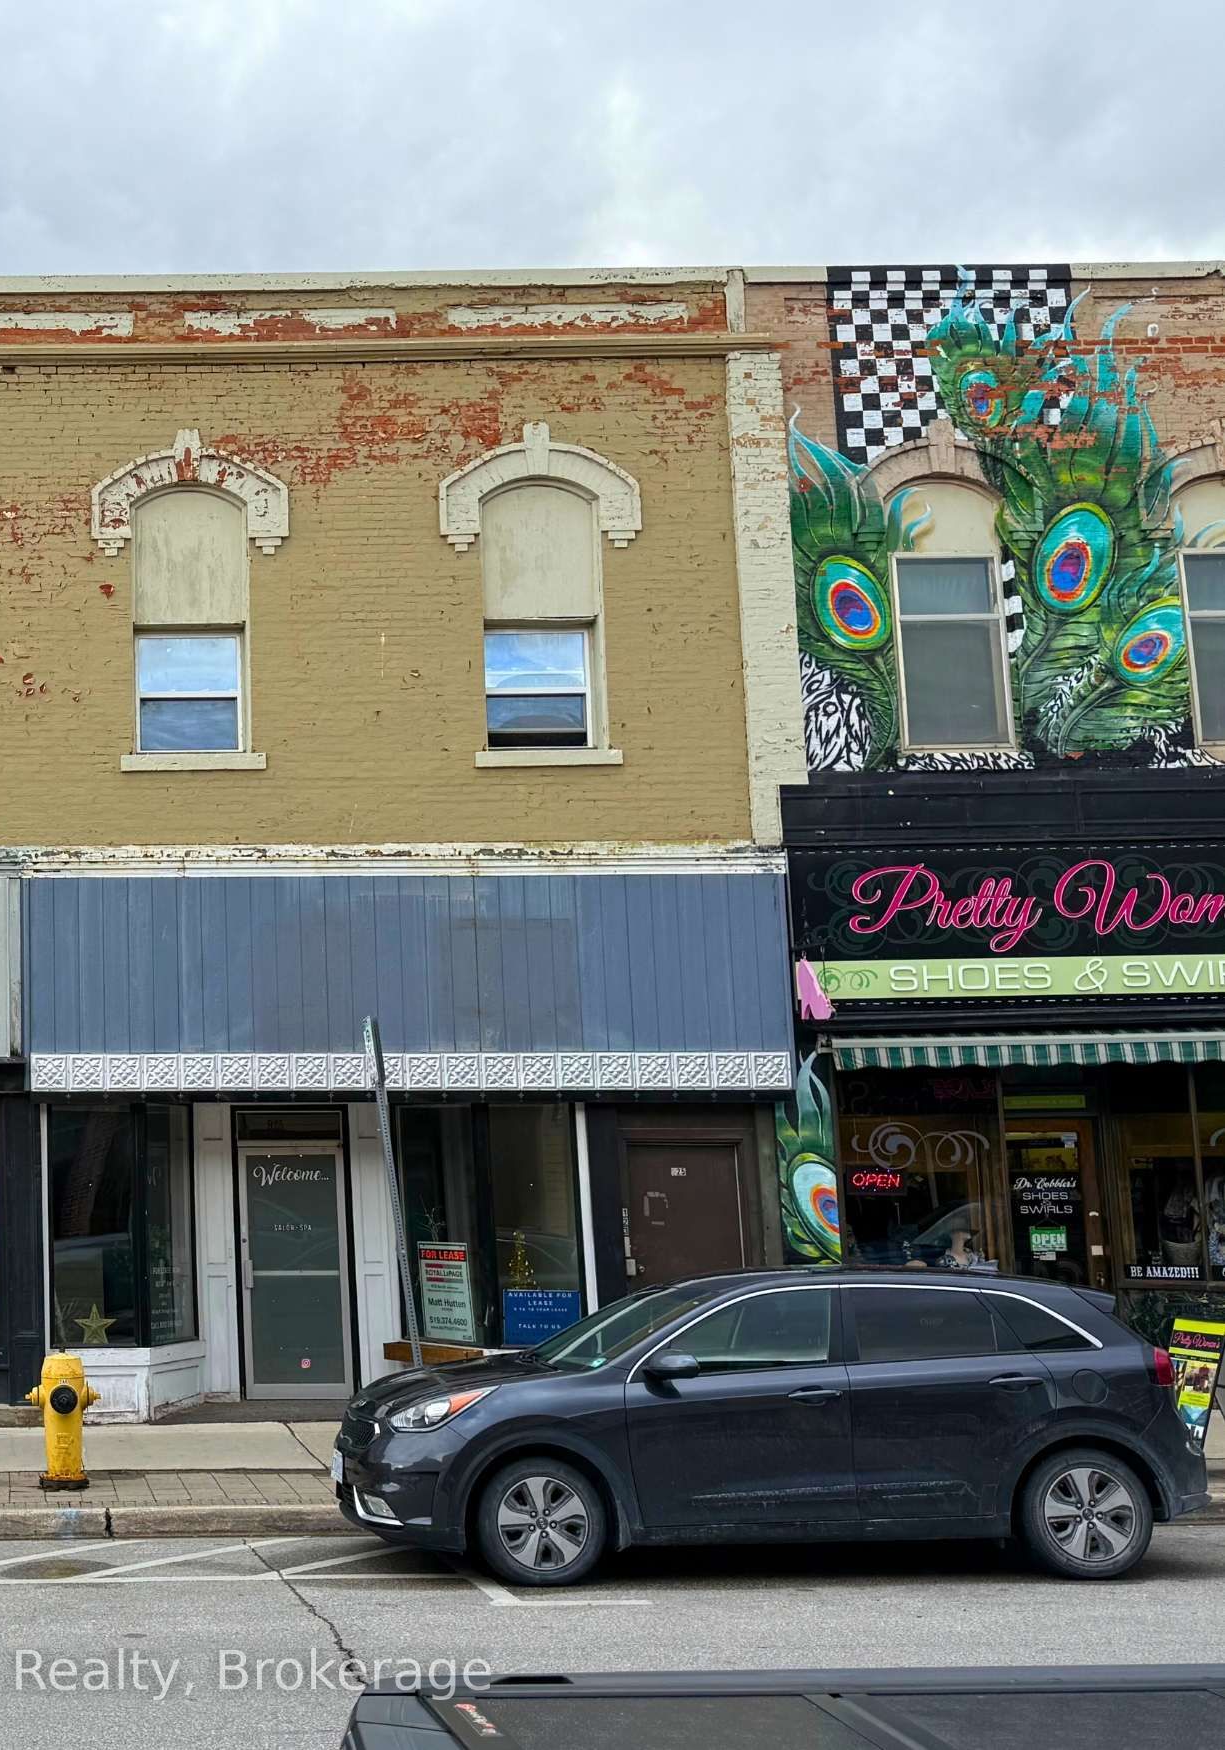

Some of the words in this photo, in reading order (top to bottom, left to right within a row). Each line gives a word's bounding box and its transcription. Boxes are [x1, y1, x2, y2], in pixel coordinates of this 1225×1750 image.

[849, 863, 1042, 952] Pretty
[889, 963, 1052, 992] SHOES
[1074, 958, 1108, 992] &
[852, 1173, 901, 1188] OPEN
[1014, 1176, 1033, 1191] Dr.
[1034, 1176, 1077, 1190] Cobbler's
[1022, 1191, 1069, 1201] SHOES
[1020, 1205, 1073, 1215] SWIRLS
[1031, 1233, 1067, 1246] OPEN
[421, 1249, 437, 1260] FOR
[438, 1250, 465, 1260] LEASE
[1130, 1266, 1143, 1277] BE
[1146, 1266, 1200, 1279] AMAZED!!!
